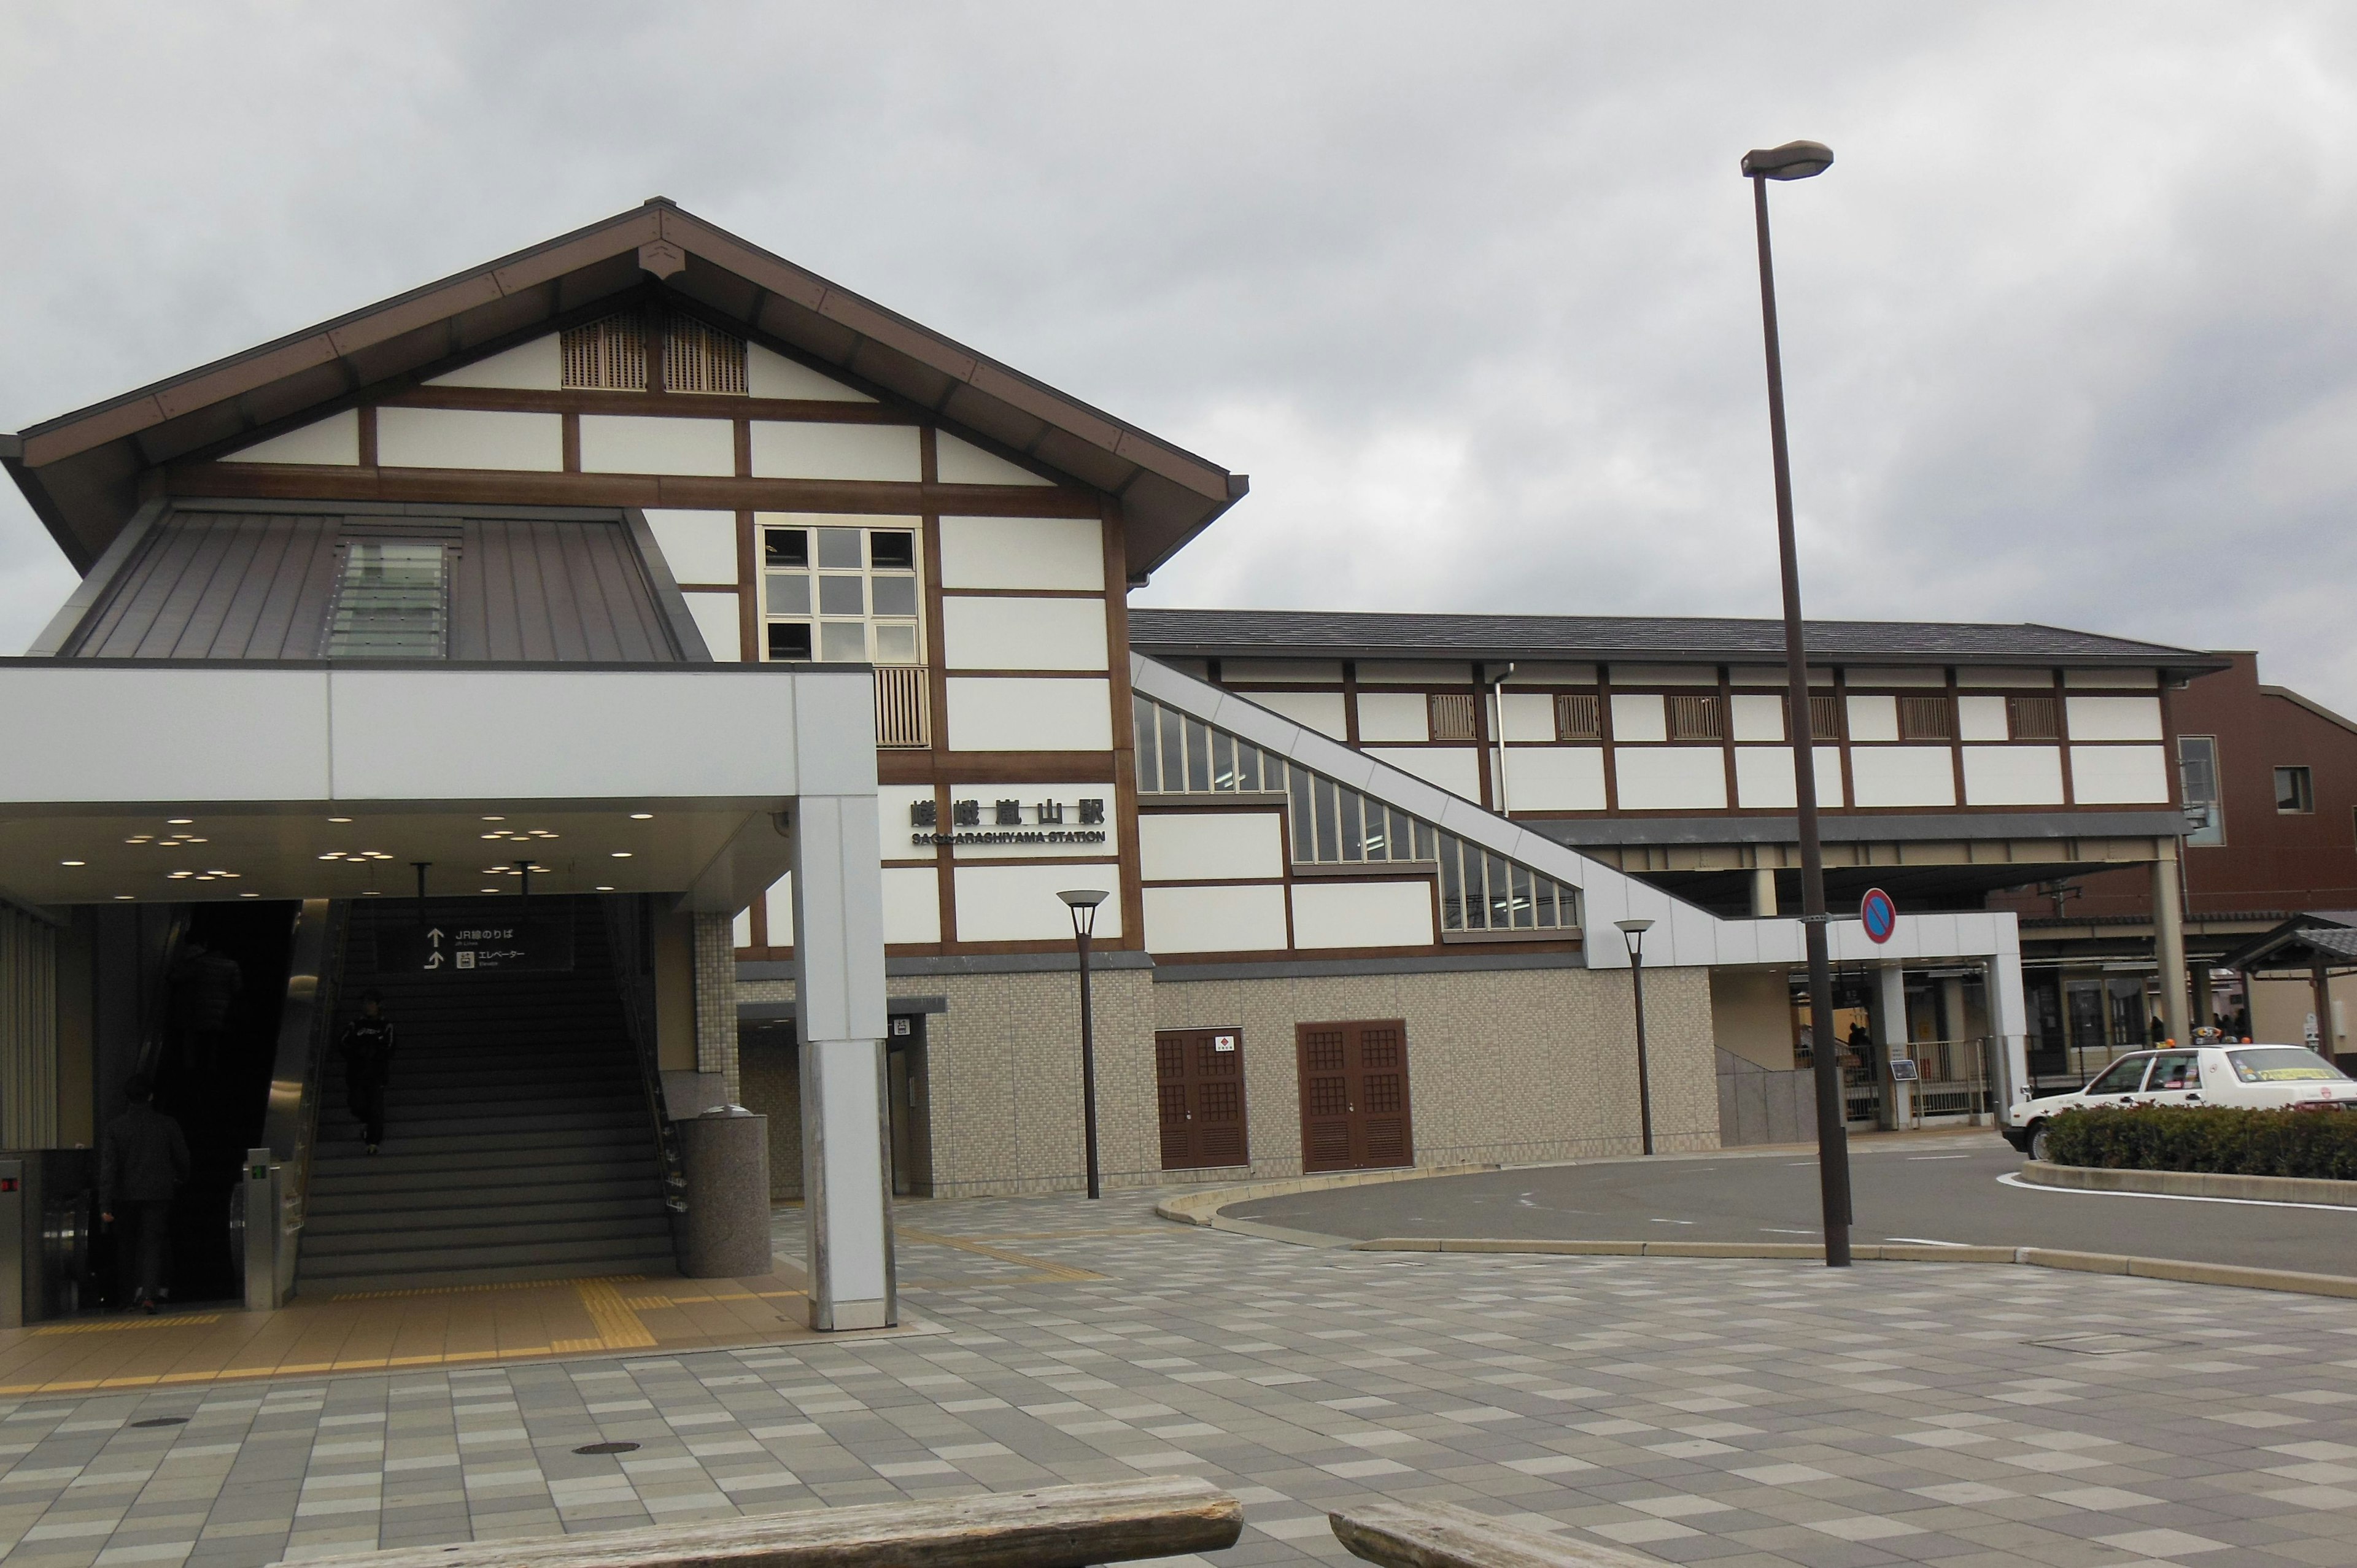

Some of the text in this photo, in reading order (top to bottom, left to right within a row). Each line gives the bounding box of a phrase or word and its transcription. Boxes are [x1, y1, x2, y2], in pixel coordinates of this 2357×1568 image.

[911, 798, 1105, 827] 嵯峨嵐山駅
[1048, 830, 1105, 843] STATION
[455, 929, 513, 940] JR線のりば
